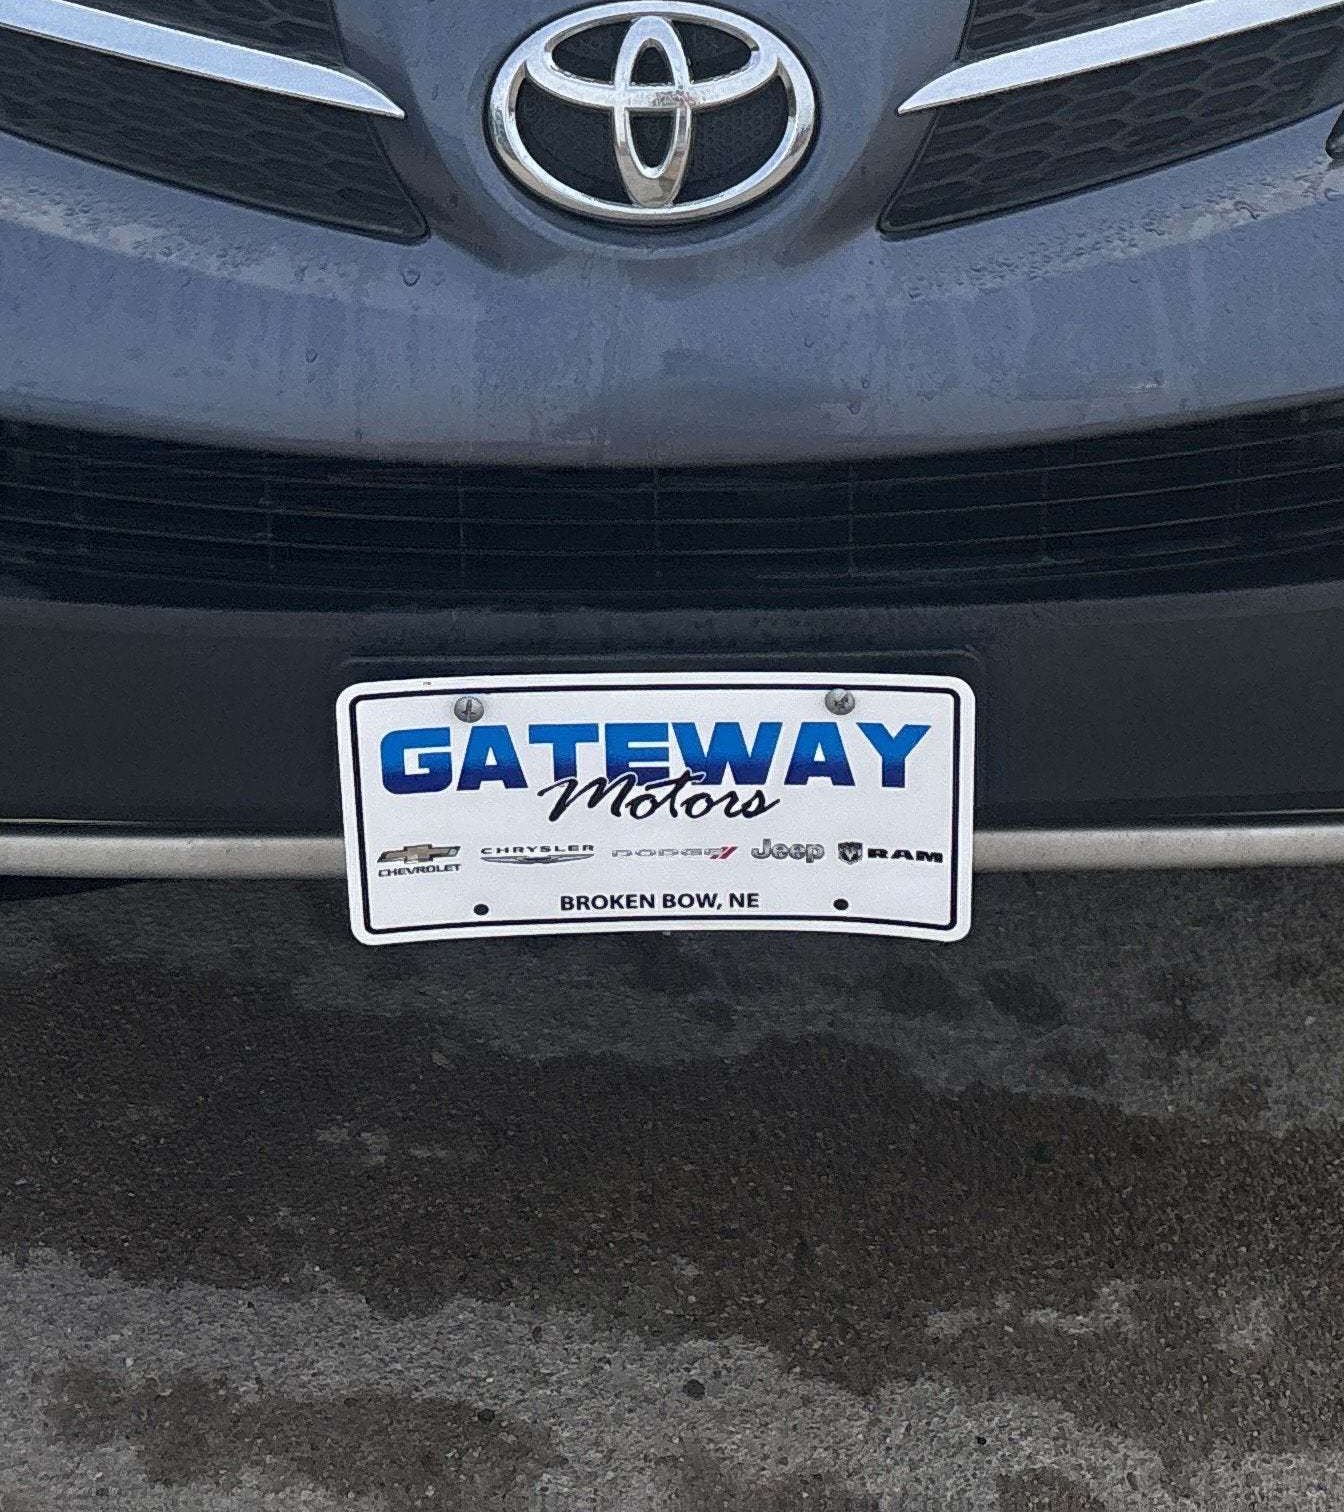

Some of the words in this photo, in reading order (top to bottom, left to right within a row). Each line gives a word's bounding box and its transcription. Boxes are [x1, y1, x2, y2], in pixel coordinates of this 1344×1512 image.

[379, 721, 932, 795] GATEWAY
[537, 770, 781, 822] Motors
[480, 844, 595, 855] CHRYSLER
[751, 838, 825, 864] Jeep
[867, 847, 944, 864] RAM
[378, 863, 462, 878] CHEVROLET
[560, 895, 655, 912] BROKEN
[662, 893, 723, 911] BOW,
[729, 892, 760, 909] NE
